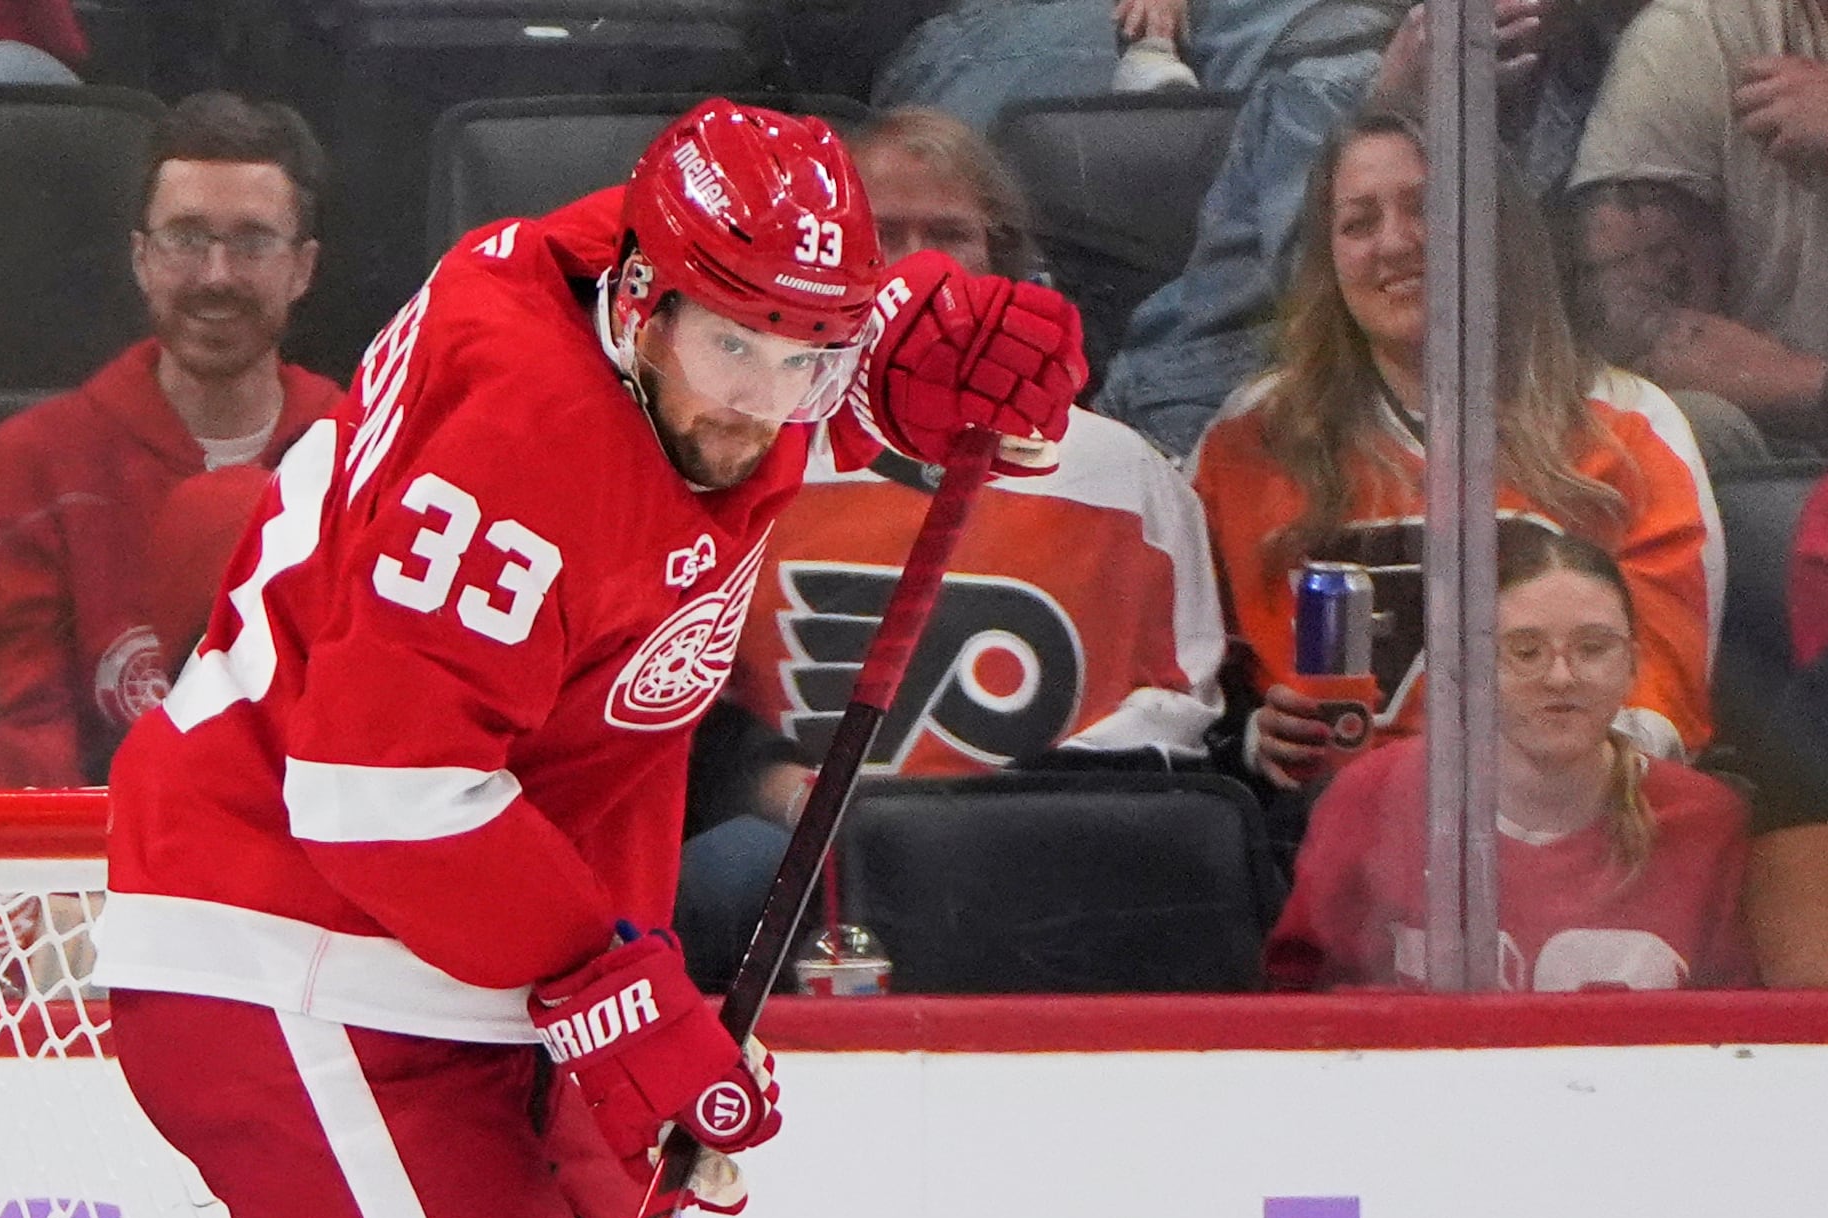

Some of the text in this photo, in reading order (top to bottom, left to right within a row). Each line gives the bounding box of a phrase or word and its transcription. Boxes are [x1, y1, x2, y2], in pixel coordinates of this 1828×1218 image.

[795, 212, 843, 267] 33
[775, 273, 847, 296] WARRIOR
[372, 472, 564, 646] 33
